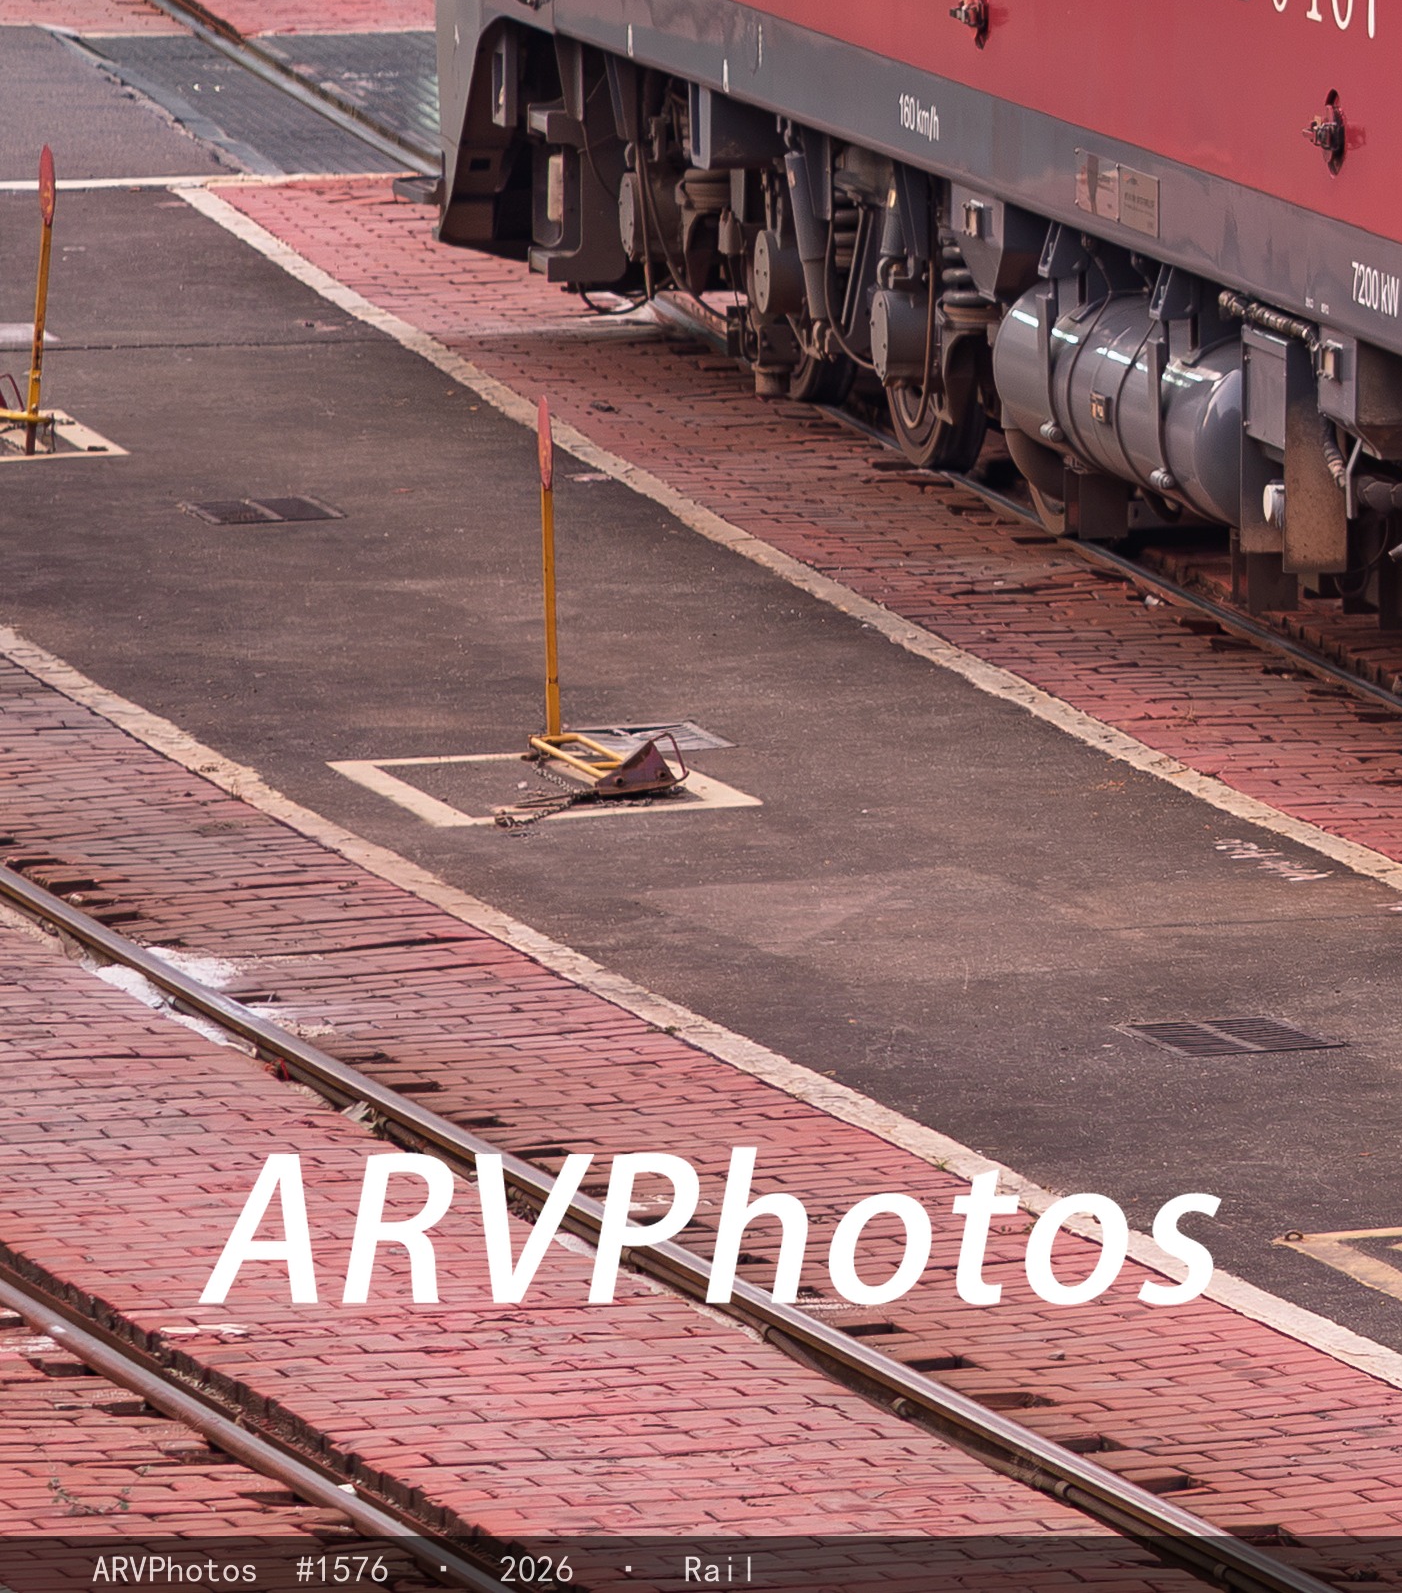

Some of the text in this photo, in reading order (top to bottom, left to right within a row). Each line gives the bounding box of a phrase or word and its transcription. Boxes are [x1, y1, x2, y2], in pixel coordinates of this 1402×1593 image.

[899, 93, 939, 142] 160 km/h
[1351, 261, 1379, 311] 7200
[1381, 272, 1400, 318] kW
